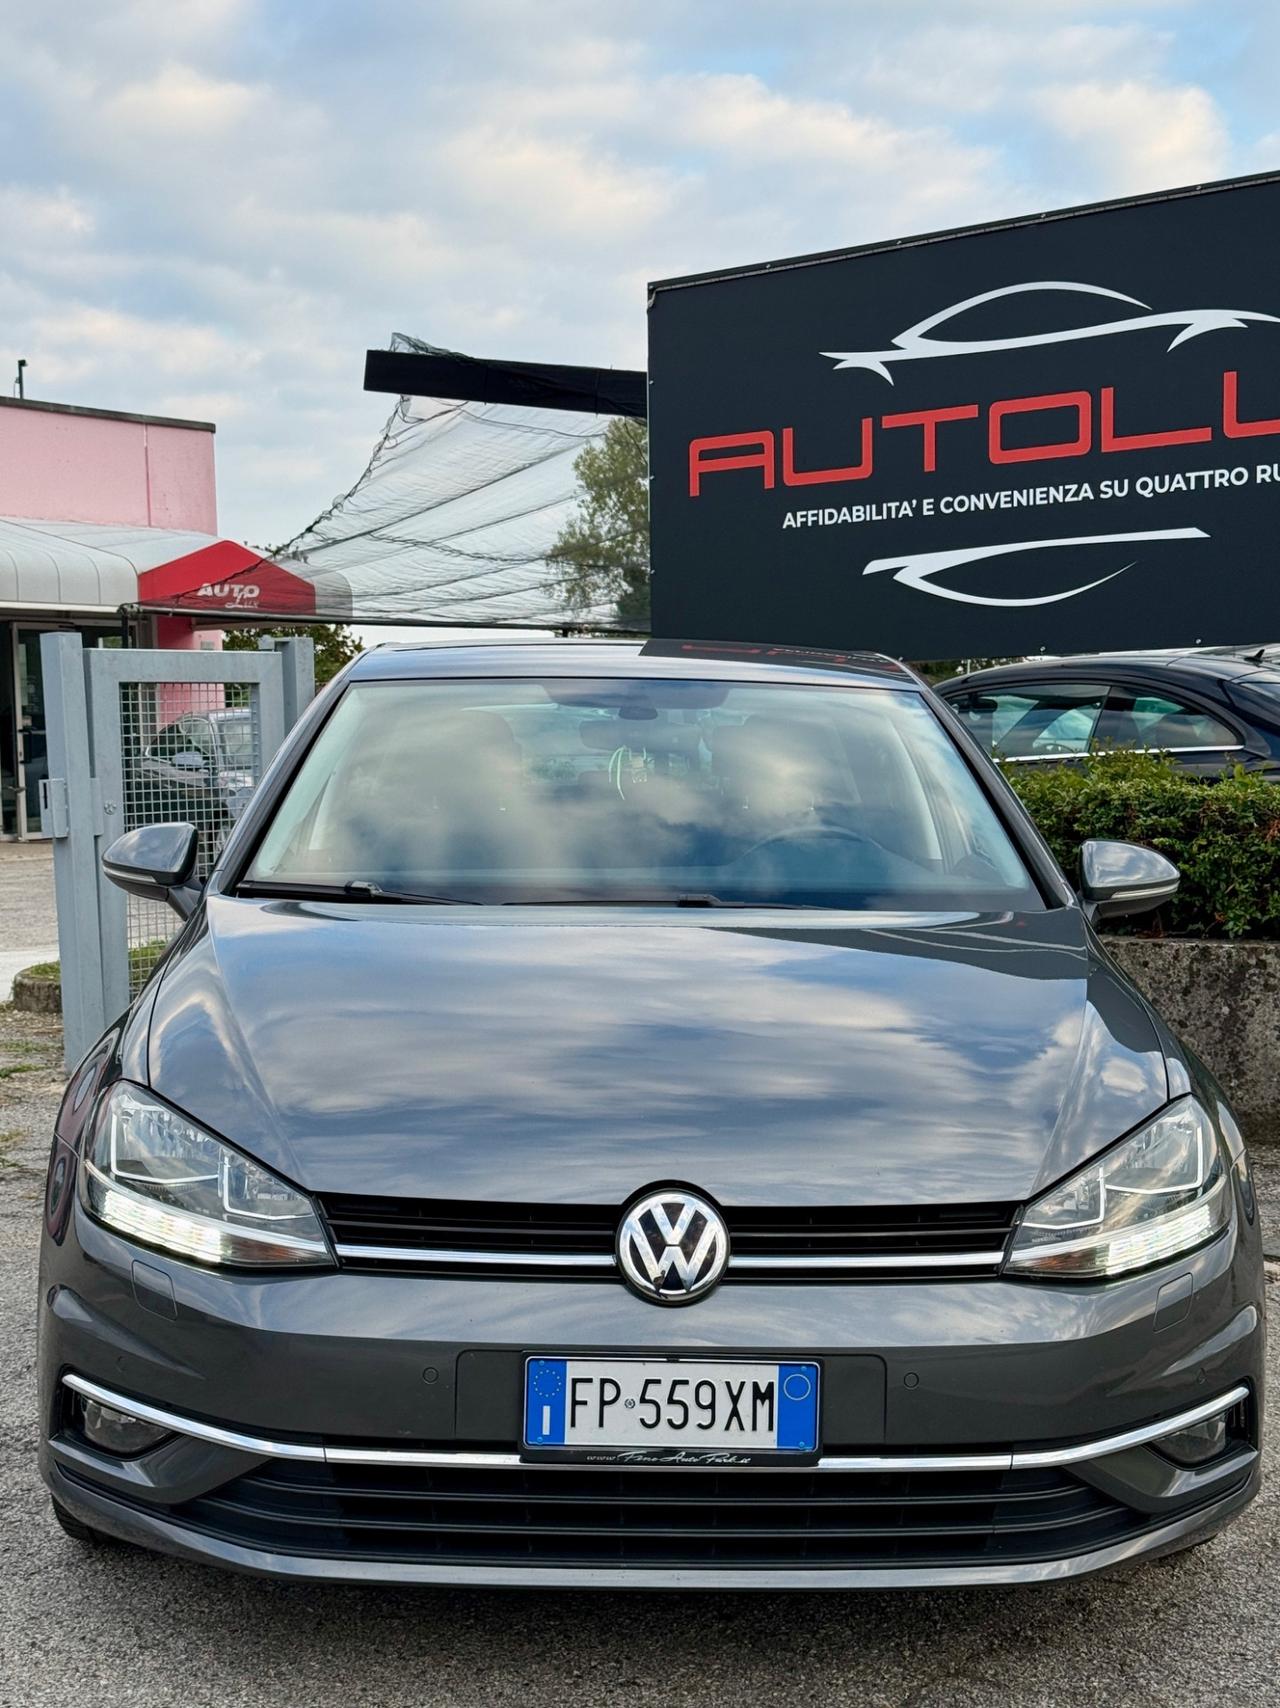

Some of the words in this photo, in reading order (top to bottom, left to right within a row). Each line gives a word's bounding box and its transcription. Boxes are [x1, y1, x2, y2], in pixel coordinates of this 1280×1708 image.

[922, 498, 935, 516] E
[939, 482, 1095, 514] CONVENIENZA
[1099, 479, 1129, 499] SU
[1135, 466, 1249, 498] QUATTRO
[197, 582, 260, 598] AUTO
[619, 1193, 727, 1295] VW
